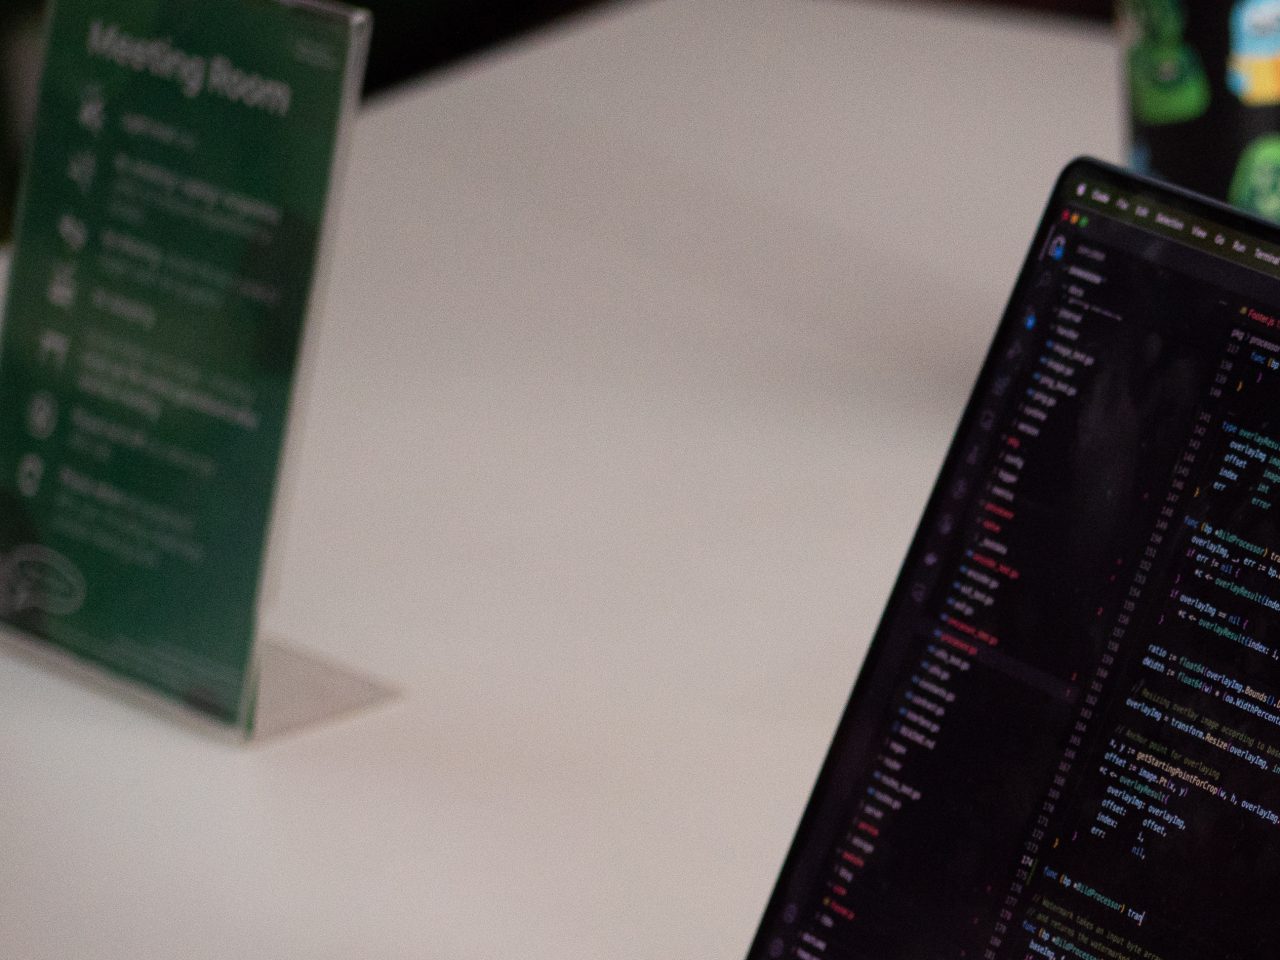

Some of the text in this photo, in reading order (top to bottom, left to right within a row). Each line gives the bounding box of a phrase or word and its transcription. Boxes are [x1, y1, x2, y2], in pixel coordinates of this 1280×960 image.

[87, 21, 292, 117] Meeting Room
[1264, 357, 1278, 370] (bp
[1220, 419, 1237, 434] type
[1223, 451, 1247, 468] offset
[1228, 438, 1266, 461] overlayImg
[1218, 465, 1269, 492] index int
[1212, 480, 1270, 509] err error
[1199, 521, 1213, 535] (bp
[1190, 533, 1232, 558] overlayImg,
[1242, 556, 1255, 567] err
[1196, 552, 1233, 573] err nil
[1179, 592, 1241, 625] overlayImg nil
[1147, 641, 1167, 657] ratio
[1142, 655, 1165, 672] dWidth
[1125, 695, 1162, 720] overlayImg
[1104, 750, 1127, 767] offset
[1118, 772, 1170, 805] overlayResult{
[1101, 796, 1169, 837] offset: offset,
[1106, 783, 1188, 830] overlayImg: overlayImg,
[1096, 810, 1119, 828] index:
[1090, 825, 1148, 860] err: nil,
[1058, 872, 1072, 887] (bp
[1037, 926, 1050, 941] (bp
